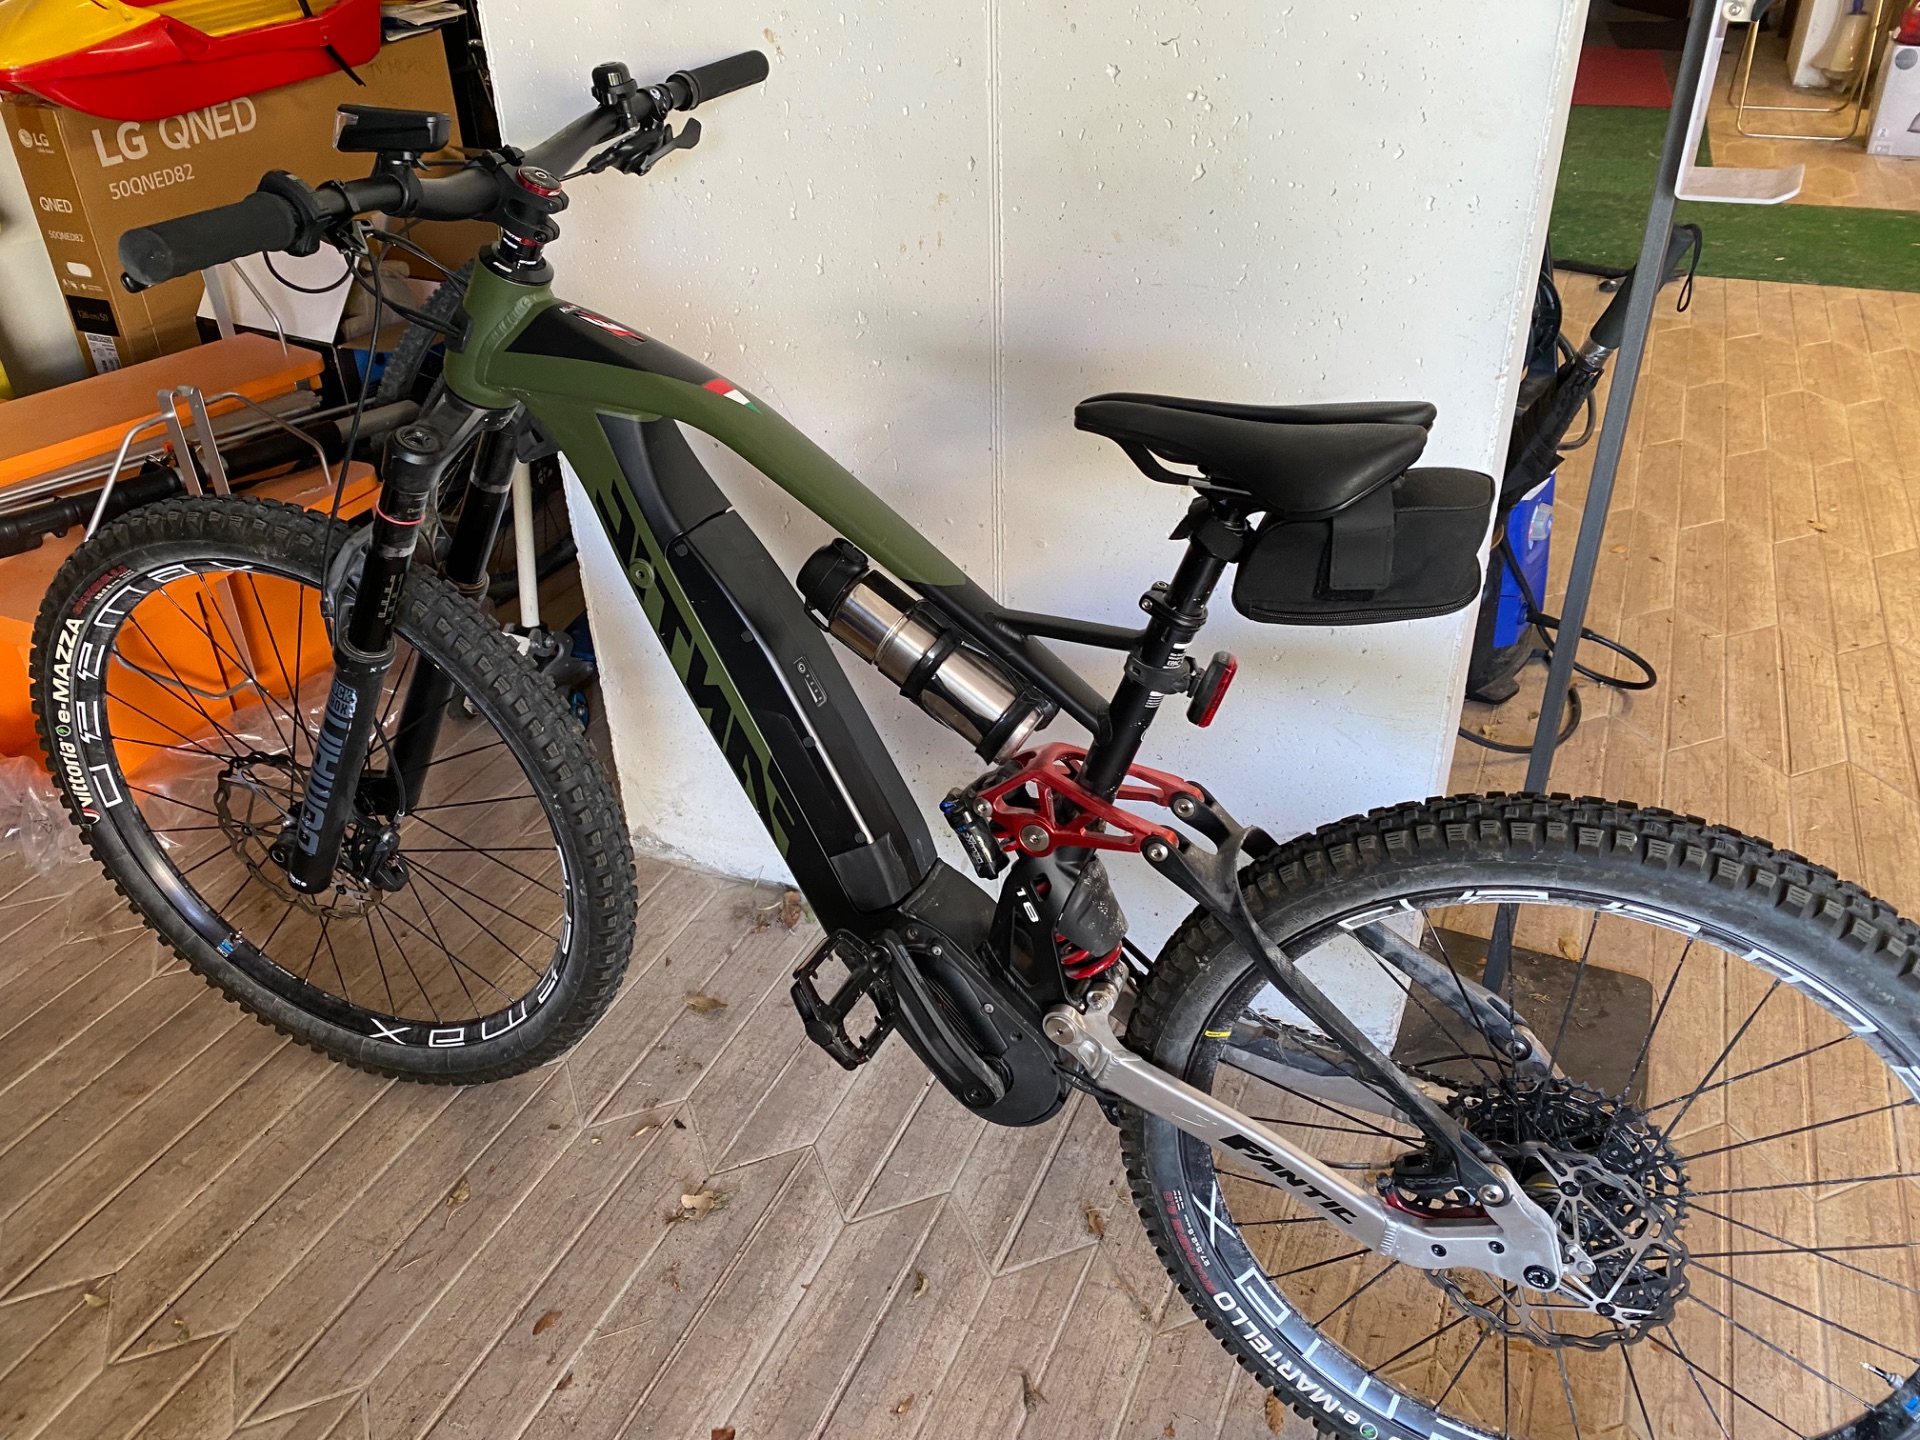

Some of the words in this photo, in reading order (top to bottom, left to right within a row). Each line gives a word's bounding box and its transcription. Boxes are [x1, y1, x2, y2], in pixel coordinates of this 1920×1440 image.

[33, 132, 50, 148] LG
[92, 121, 149, 168] LG
[158, 96, 257, 150] QNED
[39, 196, 73, 214] QNED
[109, 163, 196, 201] 50QNED82
[52, 618, 85, 725] e-MAZZA
[1218, 1133, 1359, 1226] FANTIC
[1211, 1290, 1362, 1426] e-MARTELLO
